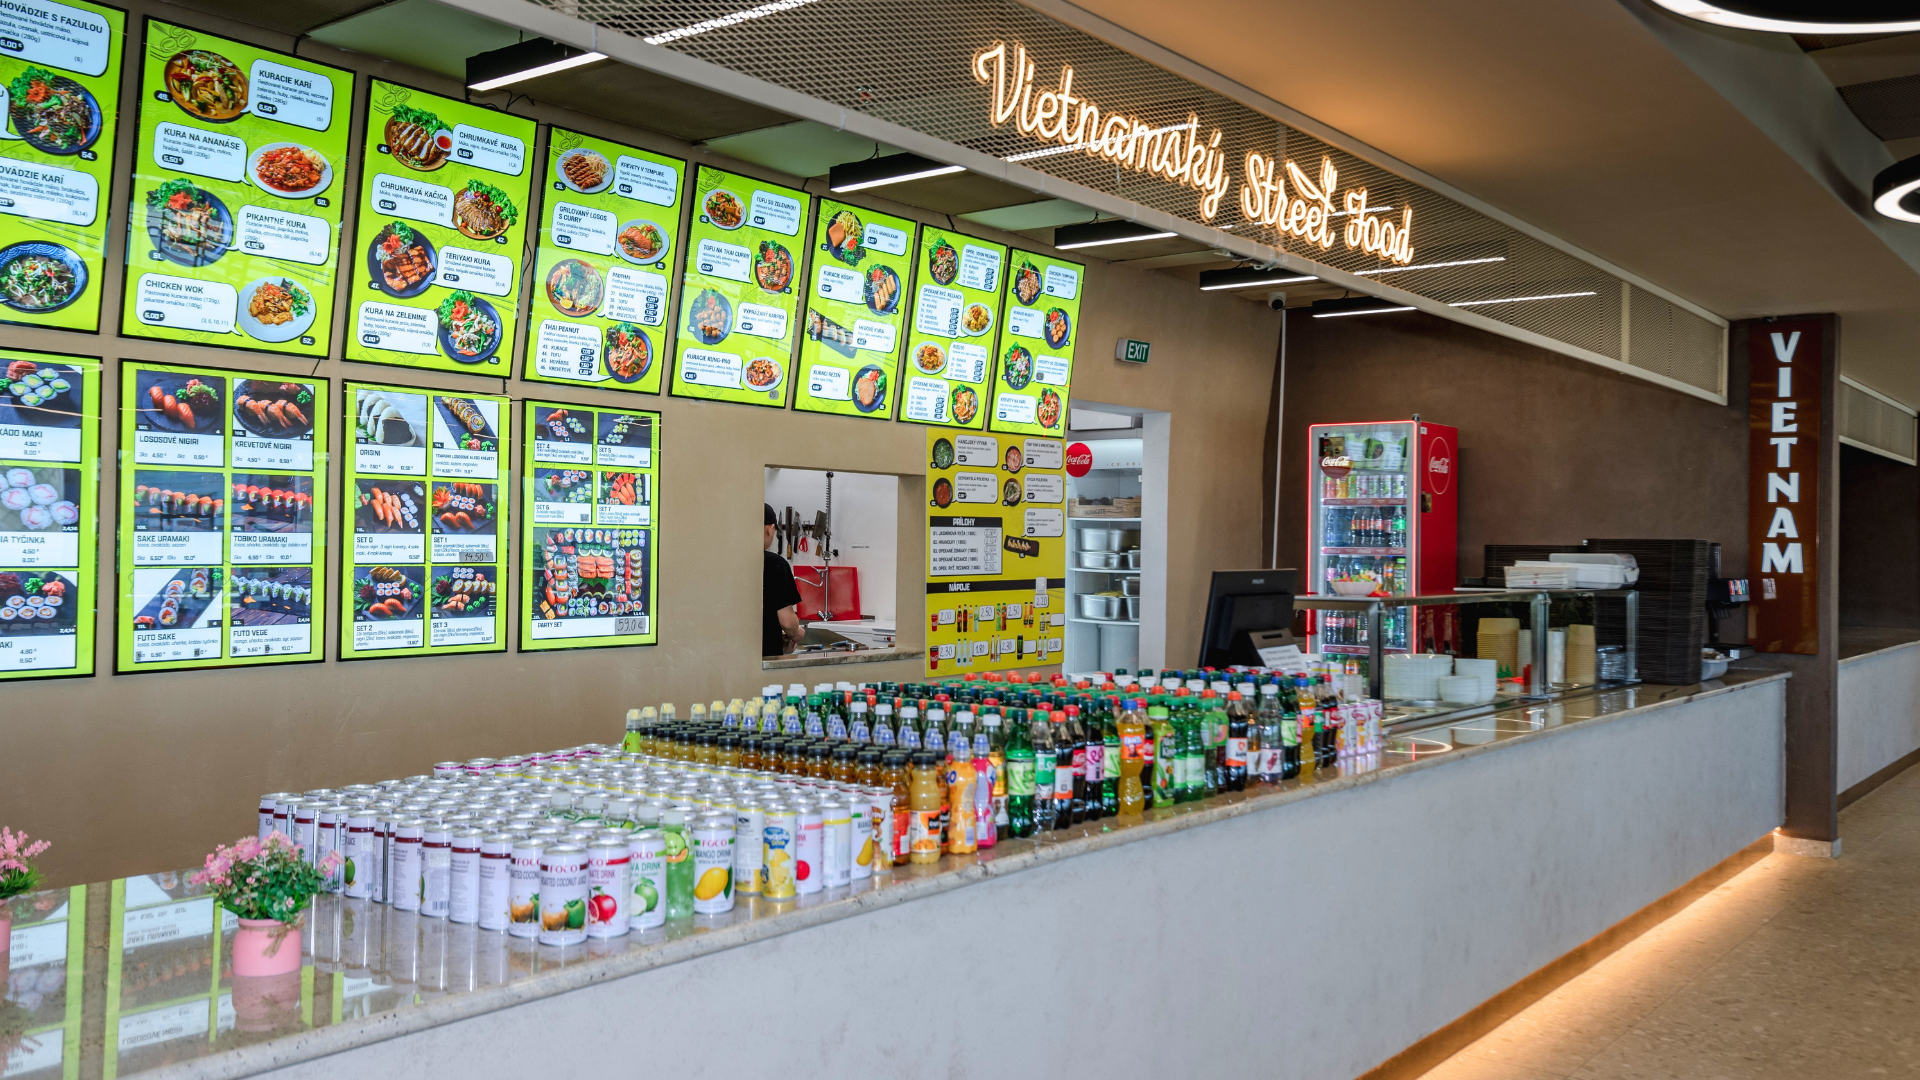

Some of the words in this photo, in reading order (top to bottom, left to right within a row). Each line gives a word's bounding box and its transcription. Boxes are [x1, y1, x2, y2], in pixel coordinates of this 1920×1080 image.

[51, 13, 58, 22] S
[60, 16, 103, 33] FAZULOU
[259, 69, 293, 84] KURACIE
[294, 78, 312, 89] KARÍ
[164, 127, 187, 139] KURA
[189, 133, 200, 142] NA
[202, 136, 240, 151] ANANÁSE
[459, 131, 498, 147] CHRUMKAVÉ
[500, 142, 518, 151] KURA
[973, 40, 1230, 220] Vietnamský
[1241, 150, 1335, 249] Street
[1345, 187, 1414, 263] Food
[621, 161, 640, 171] KREVETY
[41, 173, 64, 184] KARÍ
[381, 181, 422, 196] CHRUMKAVÁ
[424, 189, 448, 200] KAČICA
[756, 196, 767, 204] TOFU
[559, 206, 589, 218] GRILOVANÝ
[590, 213, 607, 221] LOSOS
[563, 214, 582, 223] CURRY
[246, 212, 285, 226] PIKANTNÉ
[286, 219, 306, 230] KURA
[703, 244, 715, 252] TOFU
[445, 252, 473, 263] TERIYAKI
[474, 258, 491, 266] KURA
[145, 280, 183, 292] CHICKEN
[184, 285, 204, 294] WOK
[365, 306, 384, 316] KURA
[396, 312, 427, 321] ZELENINE
[545, 323, 558, 331] THAI
[558, 325, 579, 333] PEANUT
[1128, 342, 1149, 360] EXIT
[22, 430, 43, 438] MAKI
[139, 435, 177, 445] LOSOSOVÉ
[178, 437, 199, 445] NIGIRI
[234, 440, 272, 449] KREVETOVÉ
[1761, 331, 1804, 574] VIETNAM
[1321, 456, 1350, 467] Coca-Cola
[1428, 456, 1450, 474] Coca-Cola
[952, 516, 976, 527] PRÍLOHY
[11, 535, 45, 544] TYČINKA
[157, 535, 190, 543] URAMAKI
[234, 535, 257, 543] TOBIKO
[948, 582, 971, 591] NÁPOJE
[137, 634, 156, 642] FUTO
[702, 839, 728, 848] FOCO
[695, 849, 716, 860] MANGO
[716, 849, 731, 859] DRINK
[550, 864, 578, 874] FOCO
[642, 861, 662, 871] DRINK
[601, 869, 616, 879] DRINK
[556, 877, 577, 887] COCONUT
